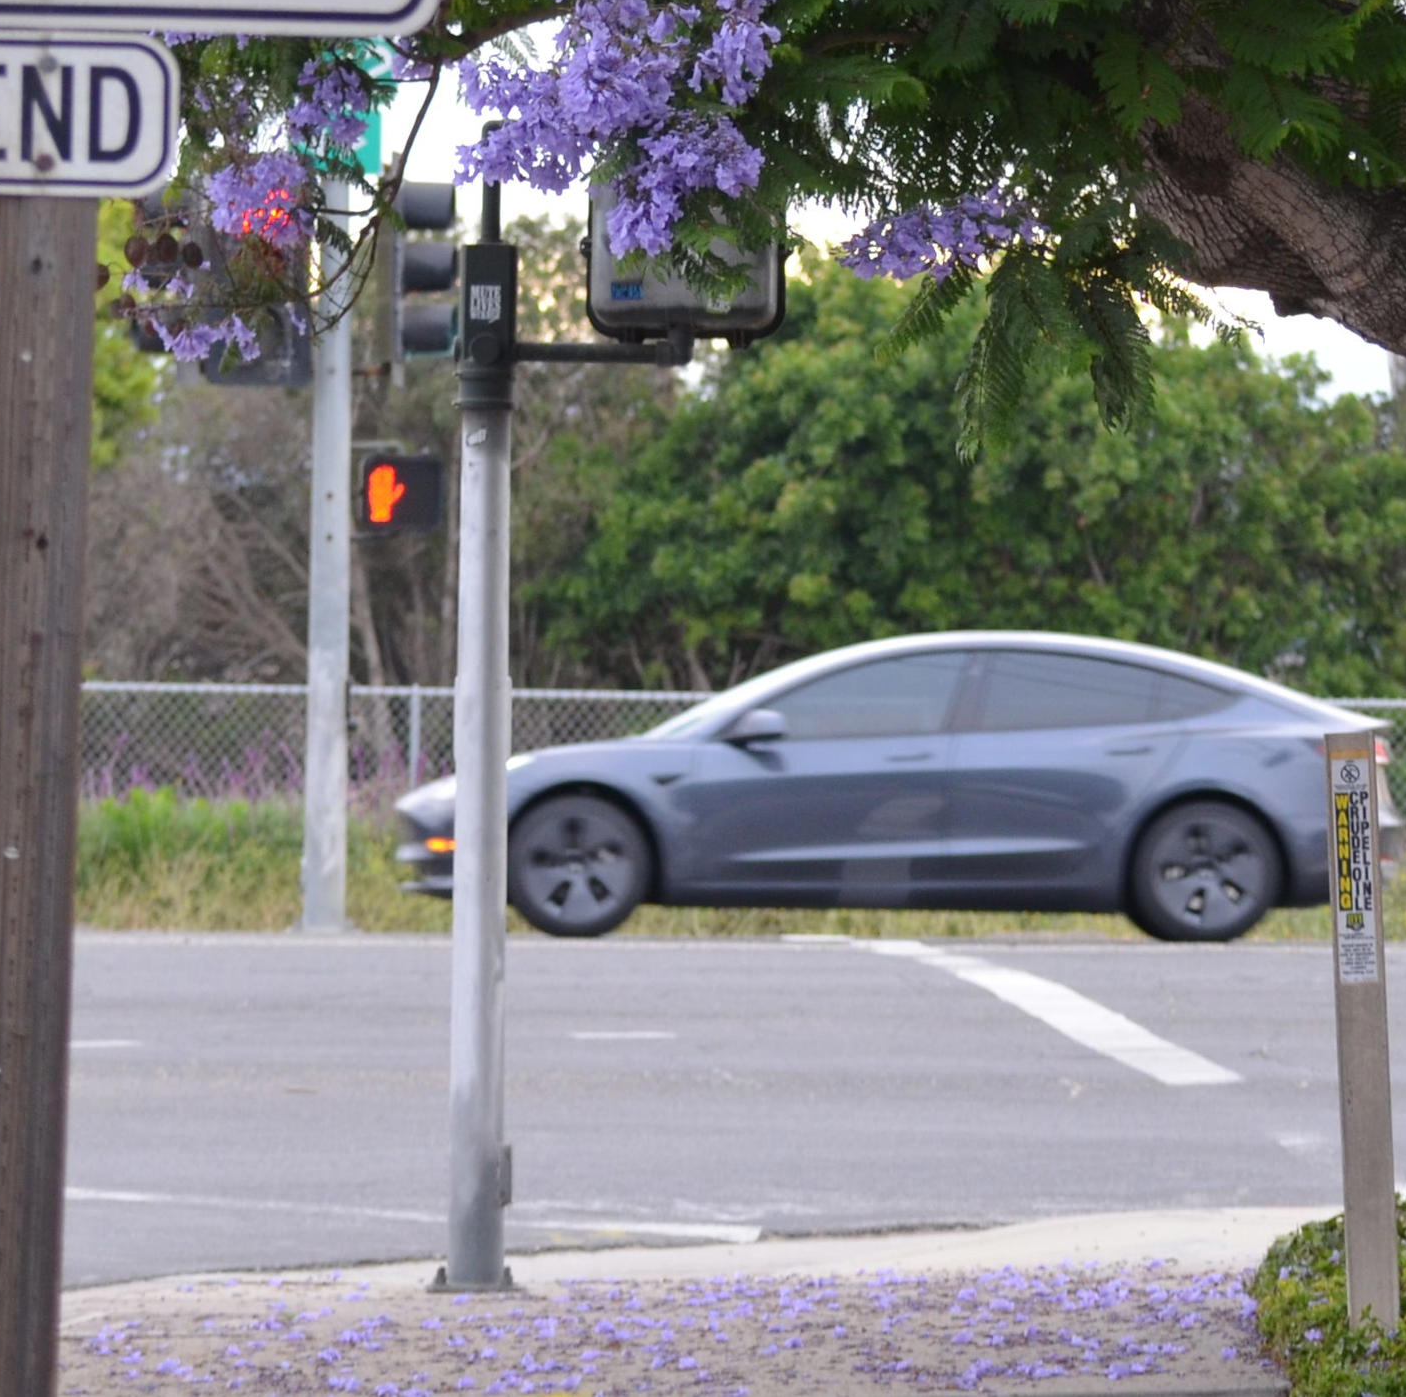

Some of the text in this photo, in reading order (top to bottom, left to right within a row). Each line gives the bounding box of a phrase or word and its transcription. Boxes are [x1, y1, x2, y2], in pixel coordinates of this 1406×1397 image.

[1335, 793, 1352, 910] WARNING
[1350, 790, 1364, 911] CRUDE OIL
[1359, 790, 1372, 910] PIPELINE
